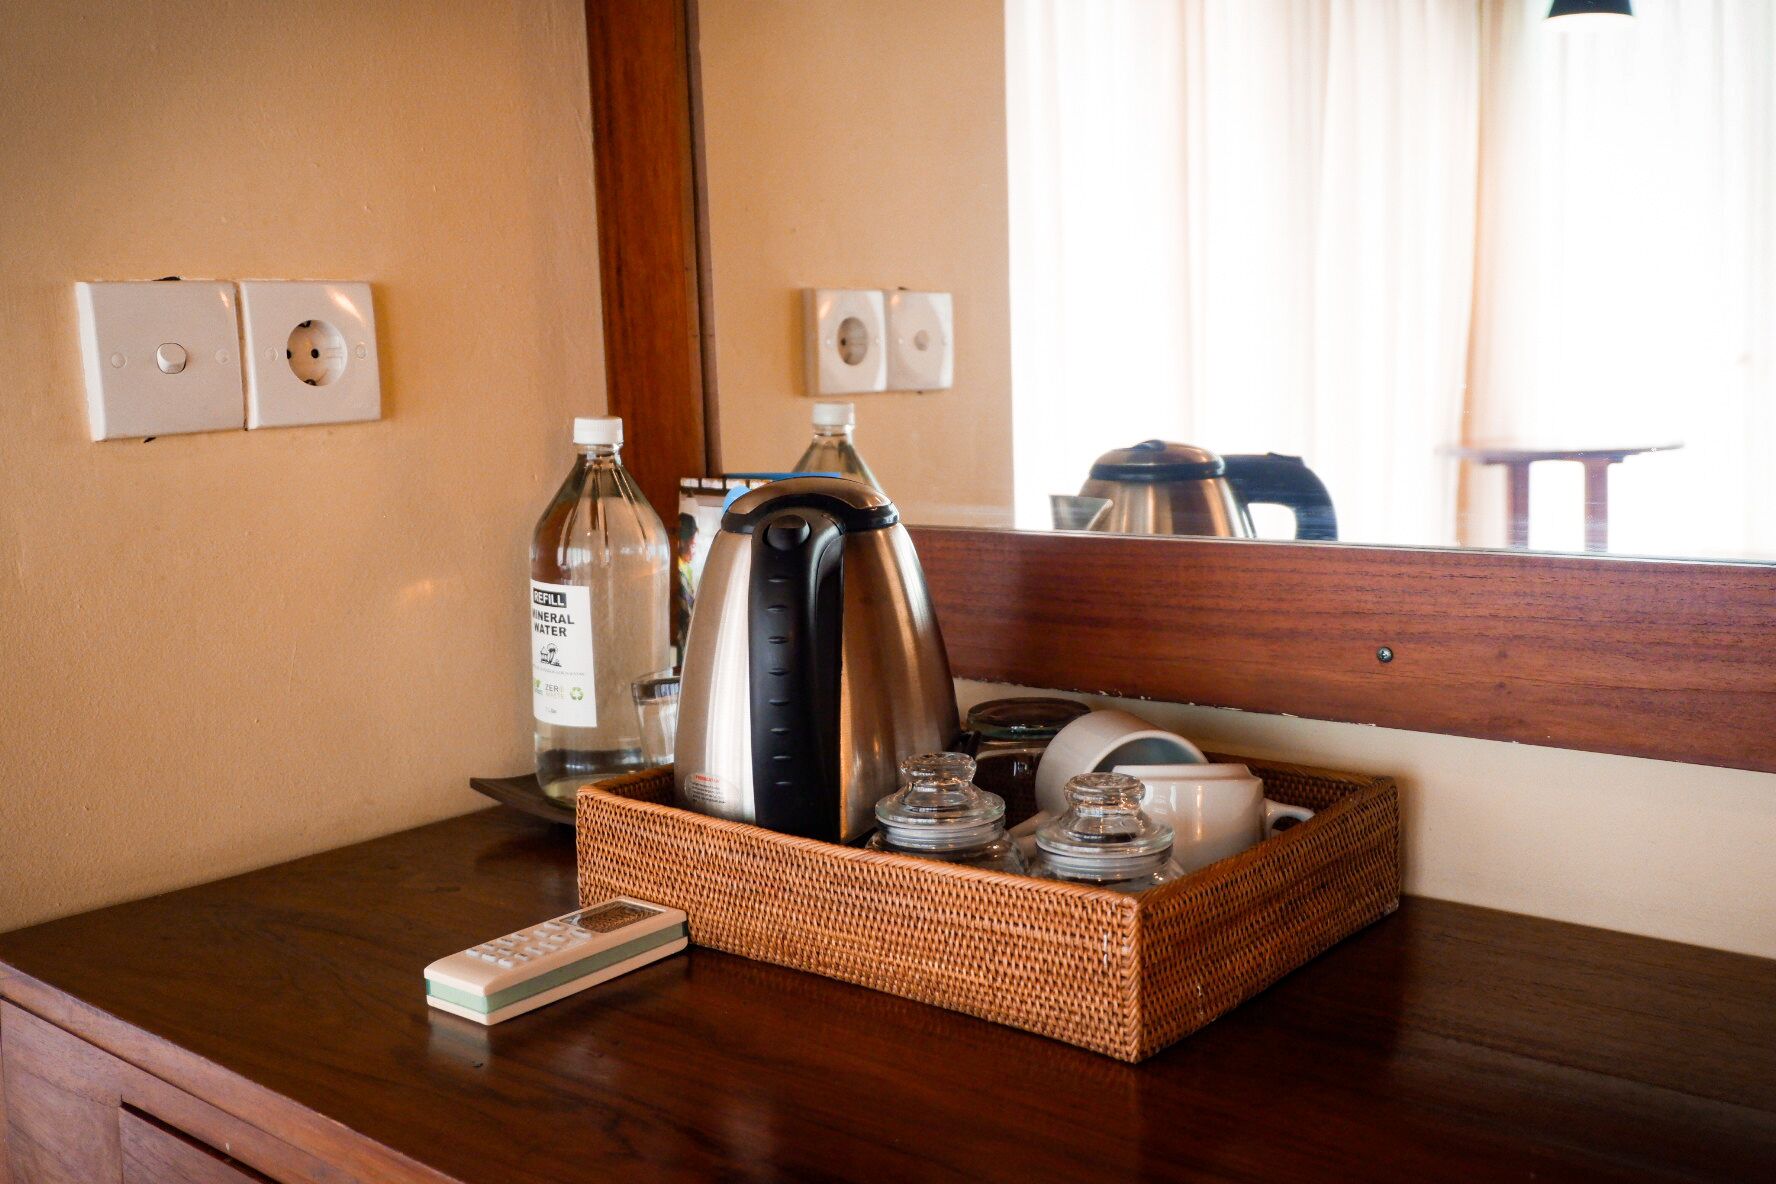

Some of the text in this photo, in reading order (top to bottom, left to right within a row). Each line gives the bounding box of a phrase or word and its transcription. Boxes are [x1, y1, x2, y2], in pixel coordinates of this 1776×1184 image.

[534, 590, 565, 606] REFILL
[534, 622, 567, 637] WATER
[545, 684, 563, 693] ZER
